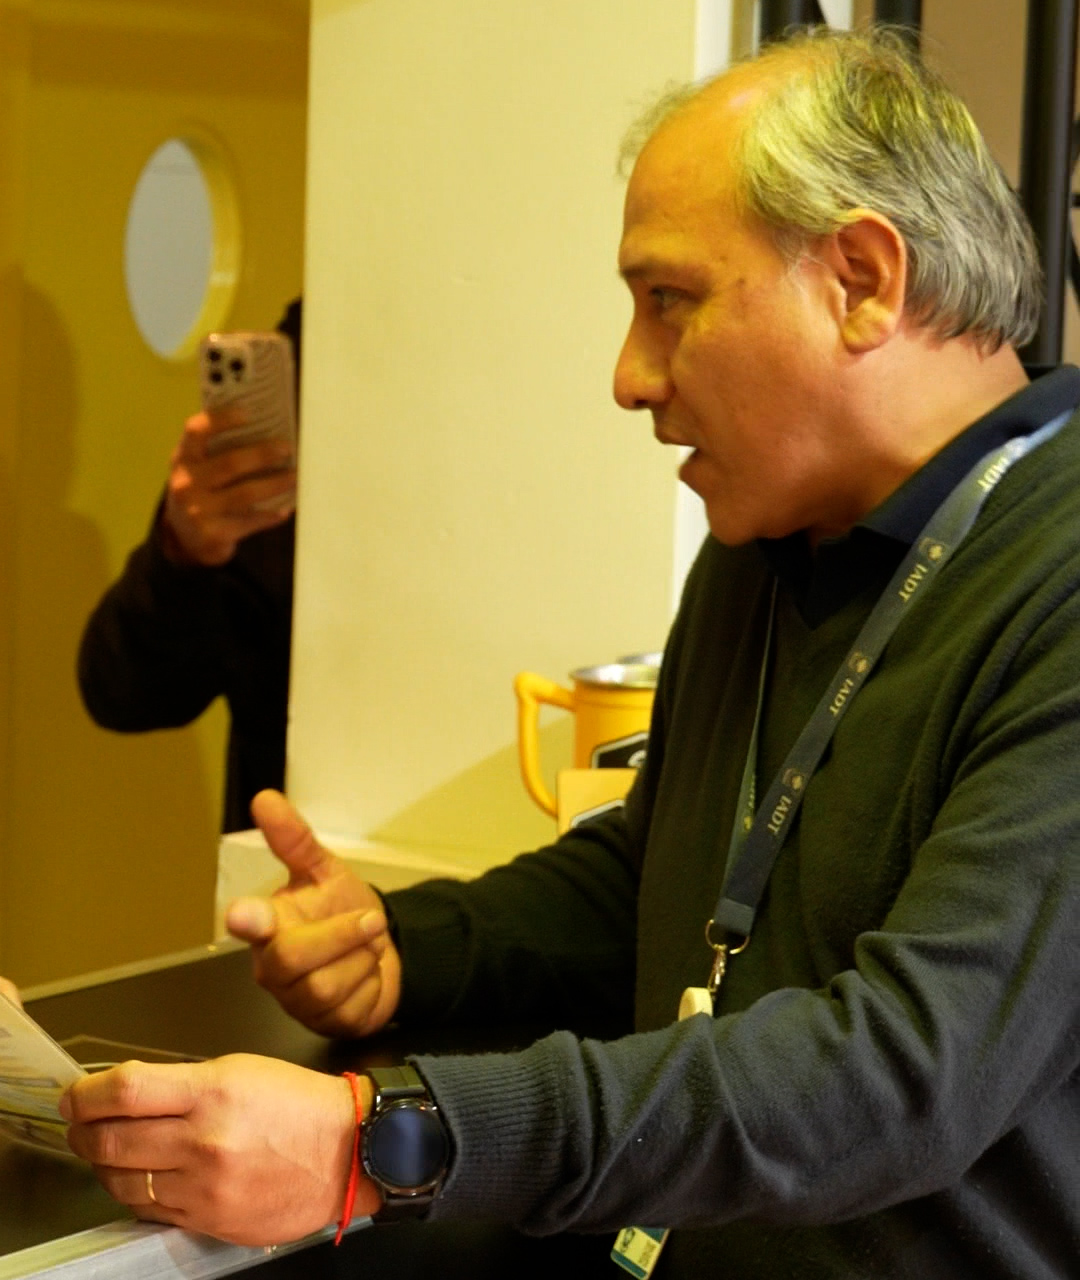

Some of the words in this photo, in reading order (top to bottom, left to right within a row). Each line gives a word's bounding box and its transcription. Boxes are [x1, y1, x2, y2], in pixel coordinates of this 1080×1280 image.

[898, 563, 928, 602] IADT
[829, 678, 854, 717] IADT
[768, 795, 792, 835] IADT
